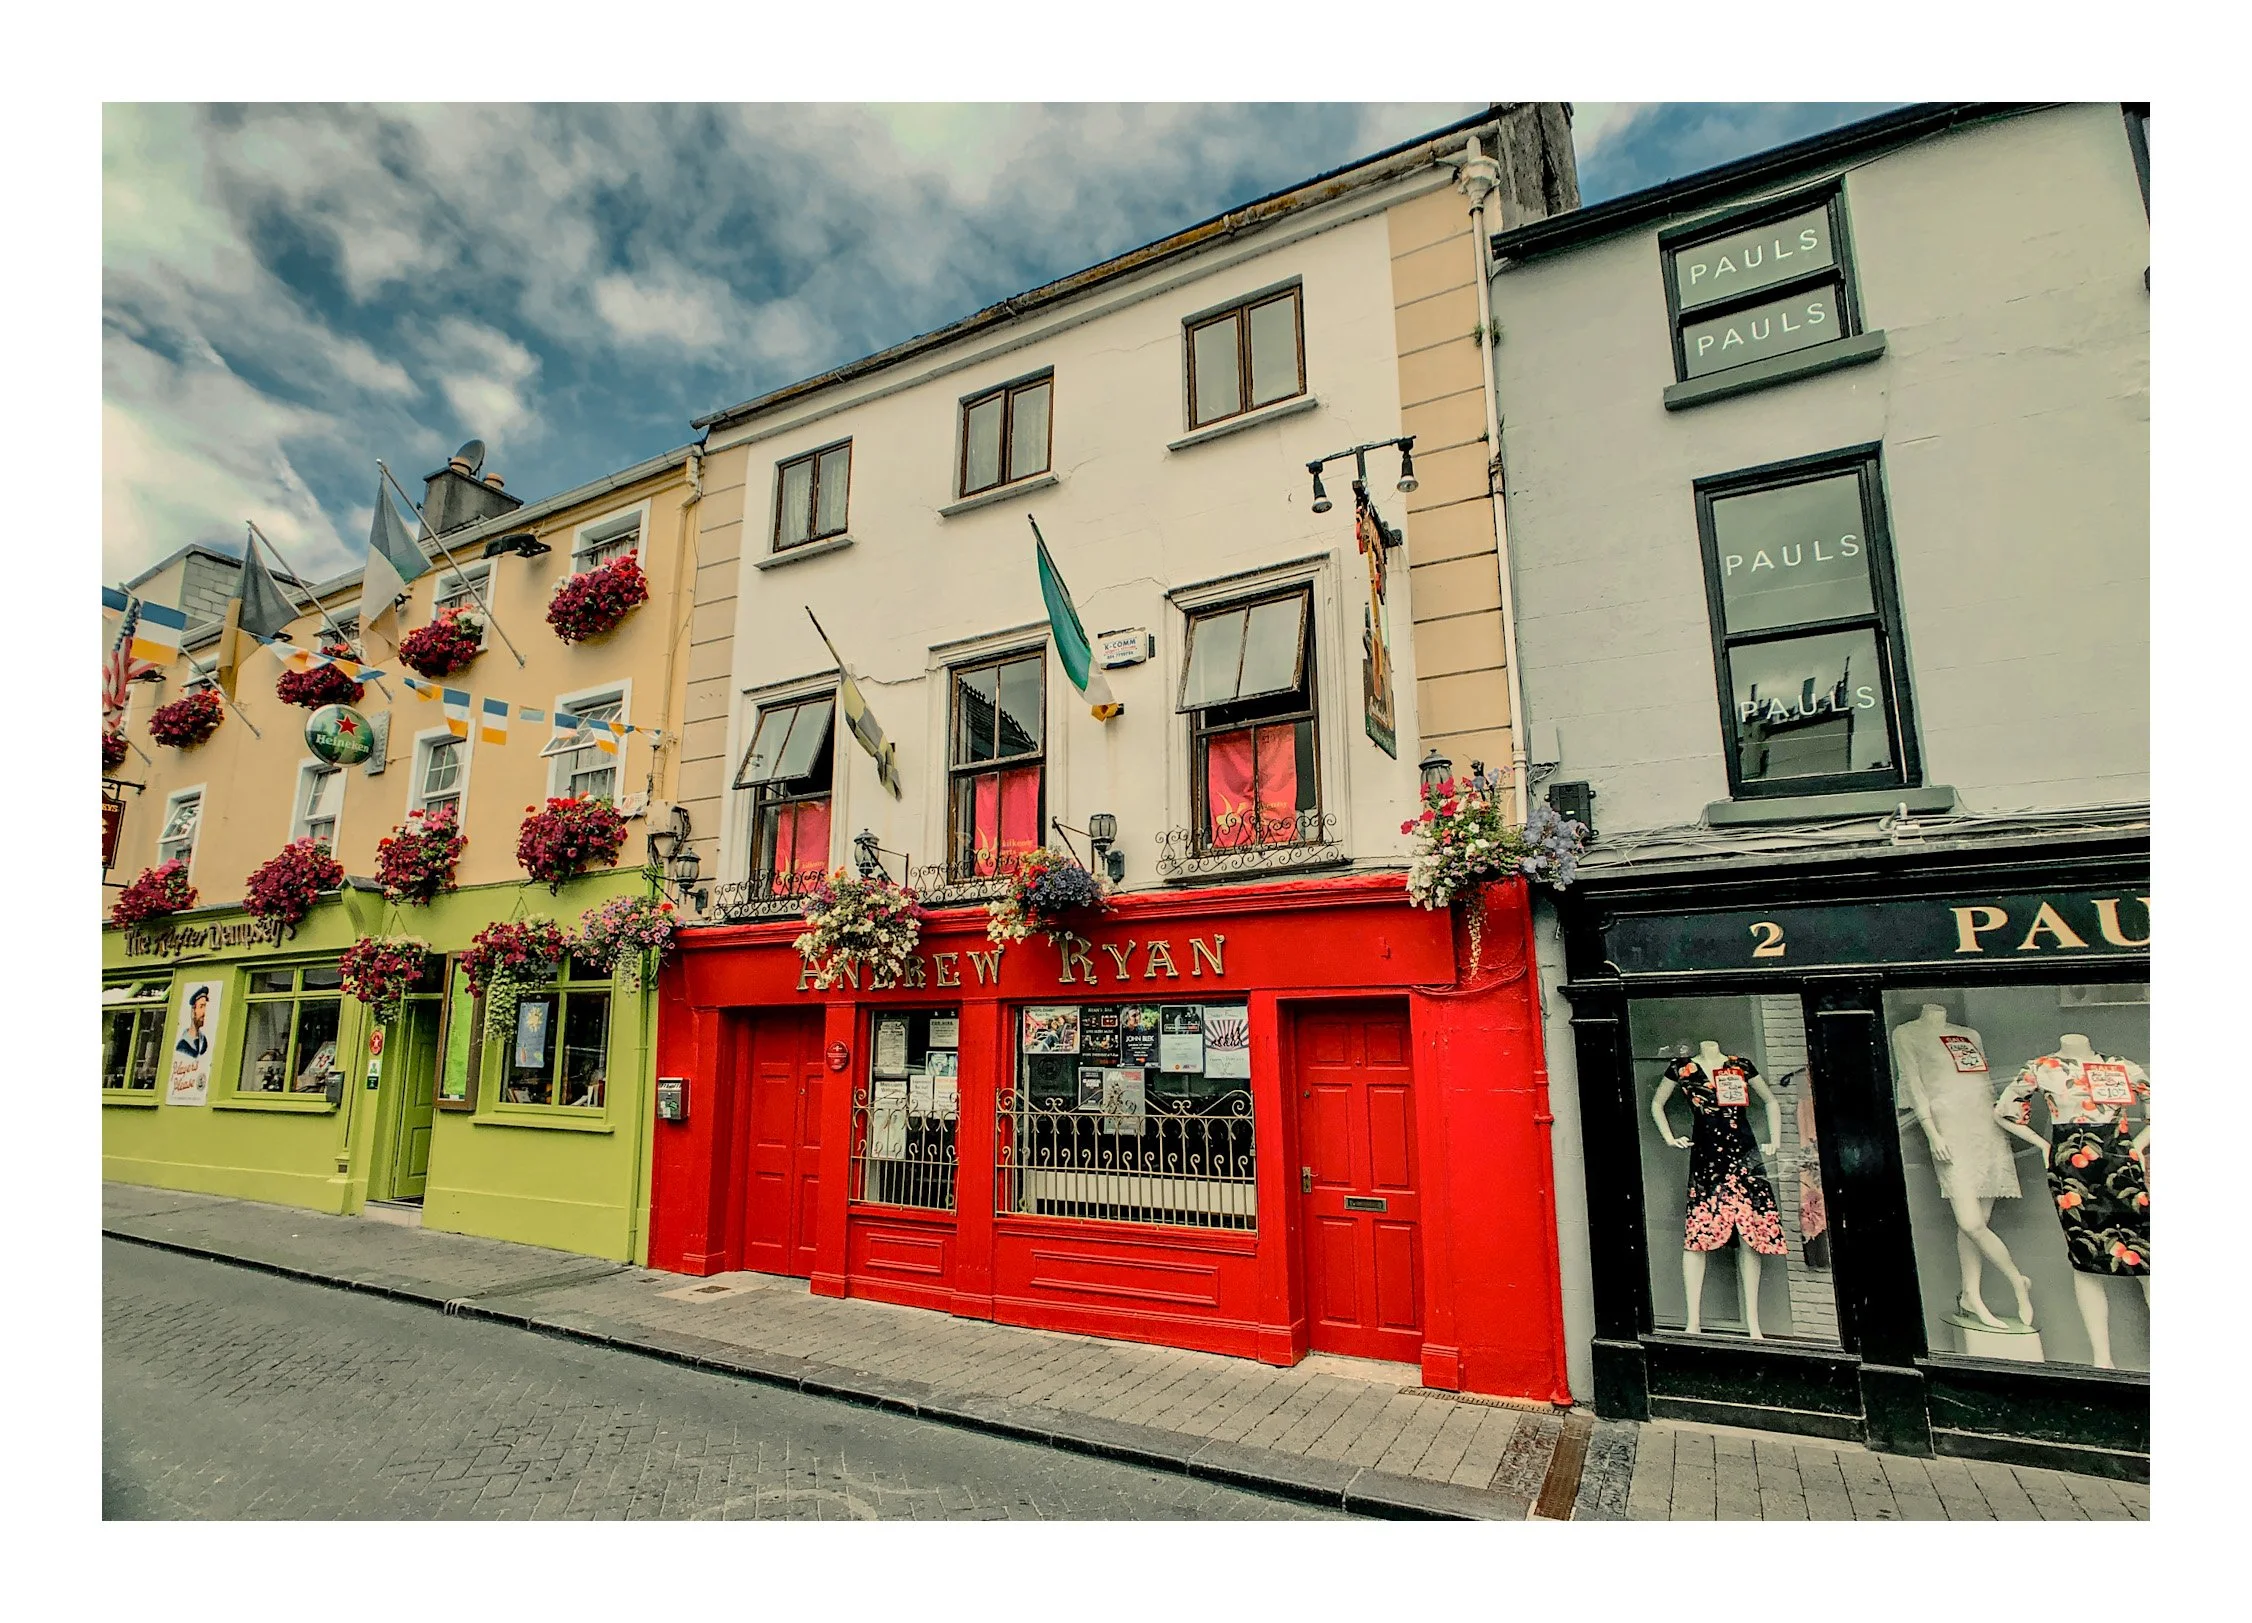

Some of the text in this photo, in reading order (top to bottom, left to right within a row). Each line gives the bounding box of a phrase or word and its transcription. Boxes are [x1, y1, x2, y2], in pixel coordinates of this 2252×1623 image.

[1689, 228, 1819, 286] PAULS
[1697, 302, 1827, 357] PAULS
[1725, 533, 1861, 577] PAULS
[1104, 639, 1136, 650] K-COMM
[1739, 686, 1877, 724] PAULS
[315, 733, 370, 754] Heineken
[124, 926, 151, 957] The
[1749, 921, 1787, 958] 2
[1058, 933, 1226, 985] RYAN
